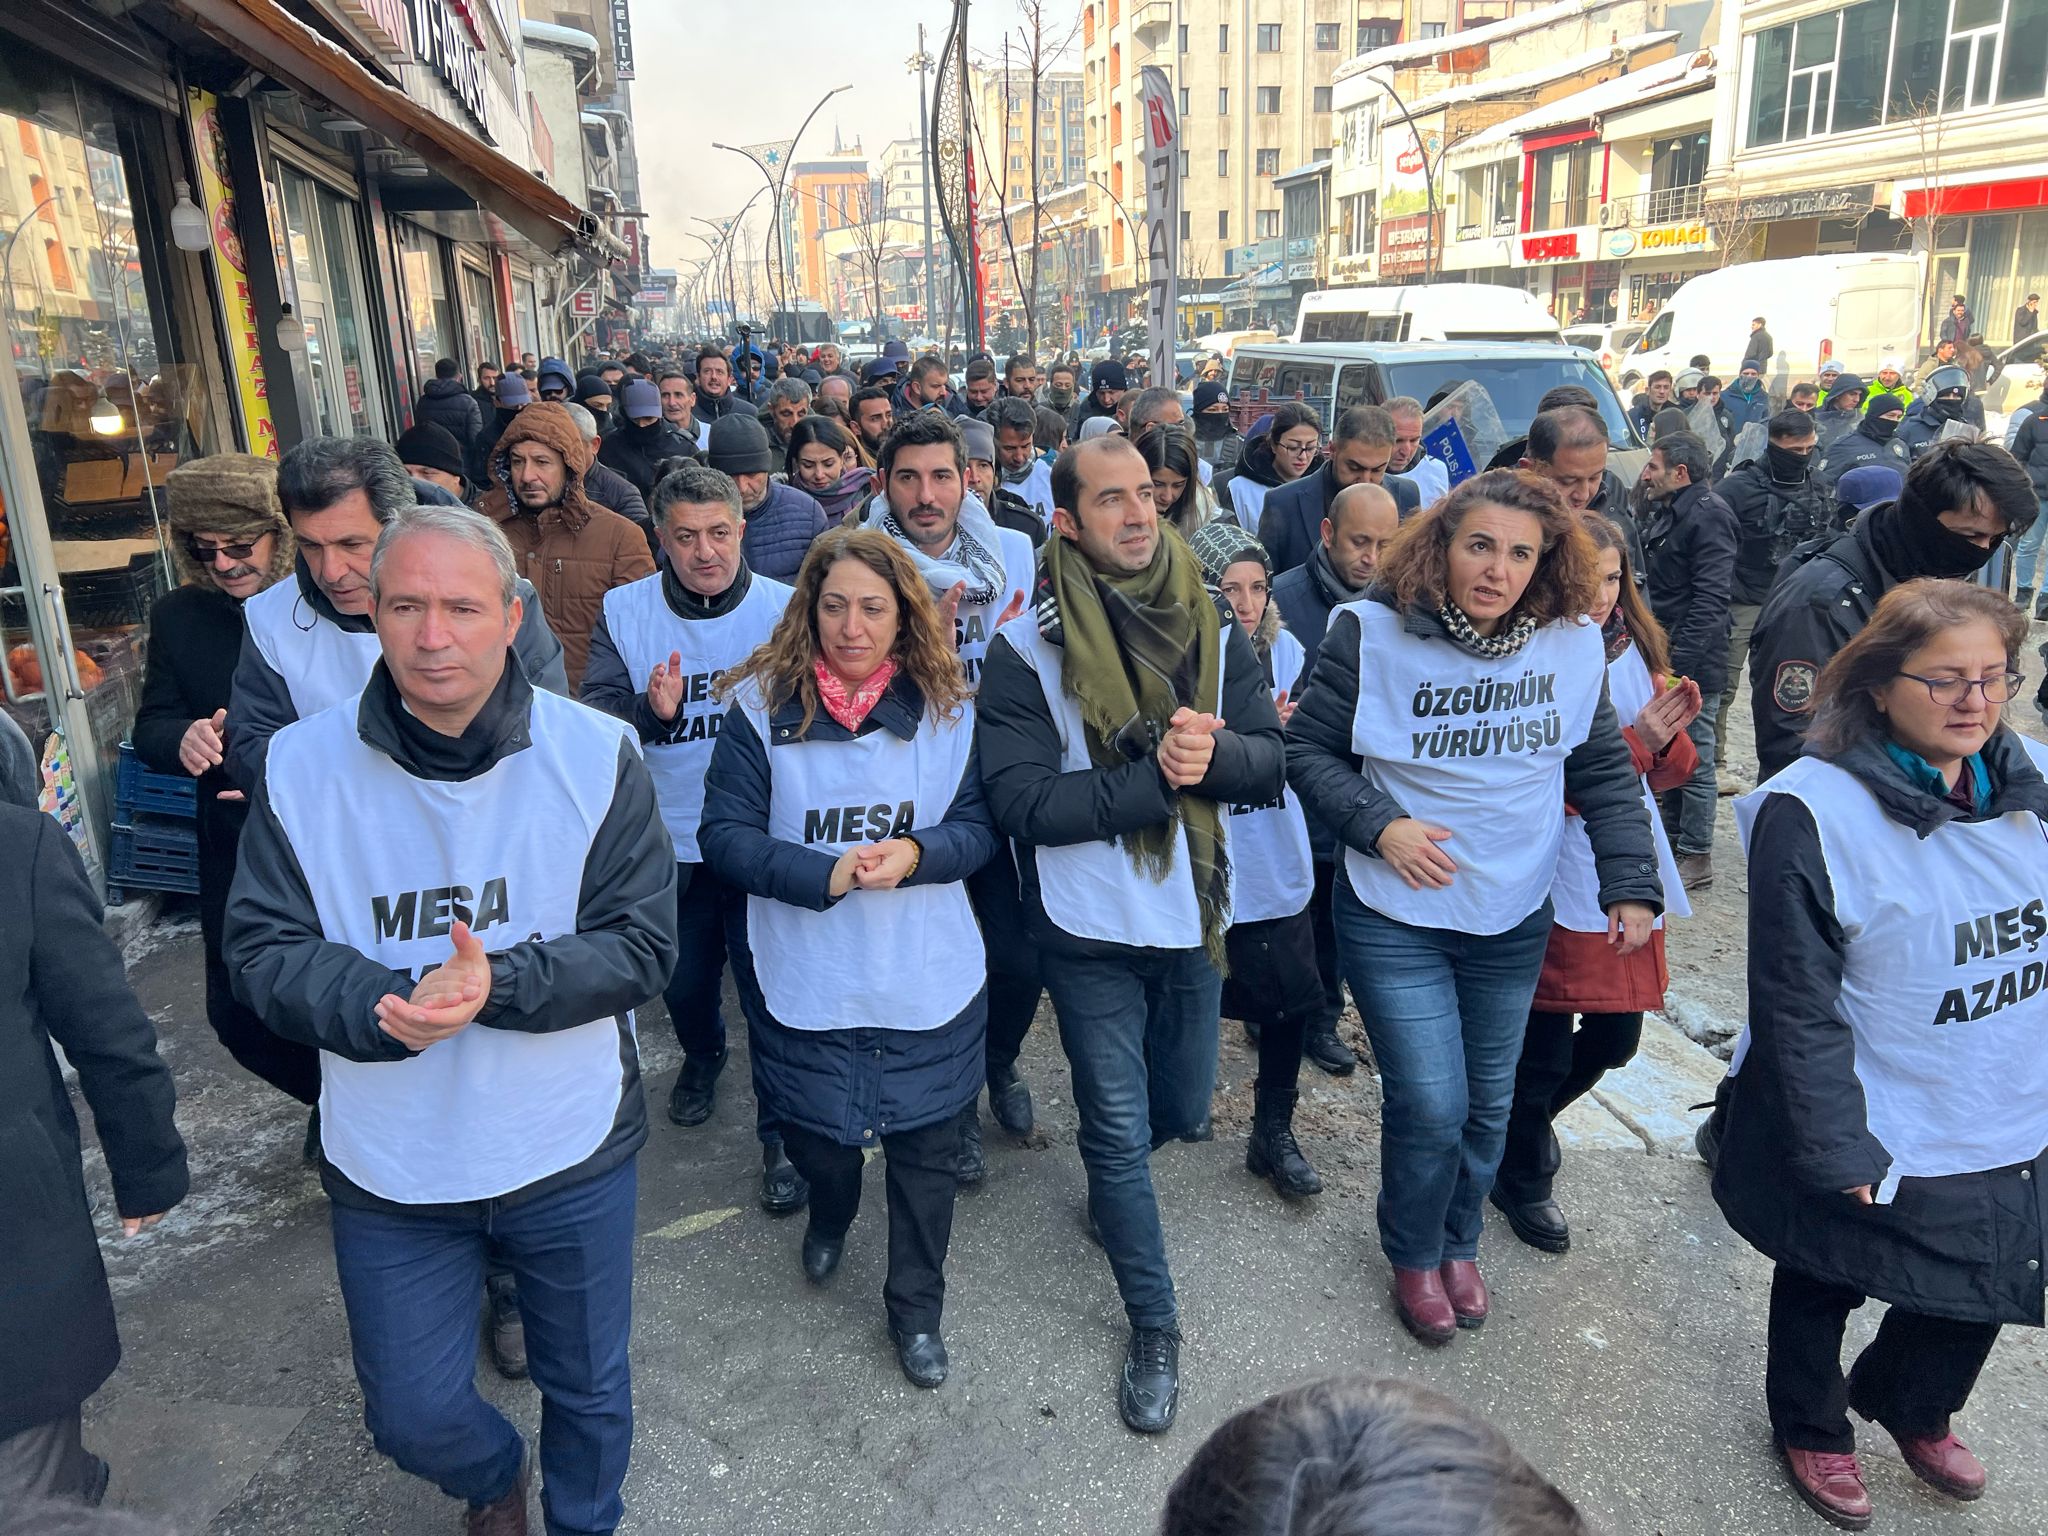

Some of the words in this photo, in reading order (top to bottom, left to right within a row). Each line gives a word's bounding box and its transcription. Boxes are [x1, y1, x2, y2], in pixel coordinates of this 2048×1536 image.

[1522, 233, 1578, 260] VESTEL
[575, 292, 593, 312] E
[1411, 708, 1561, 759] YÜRÜYÜŞÜ
